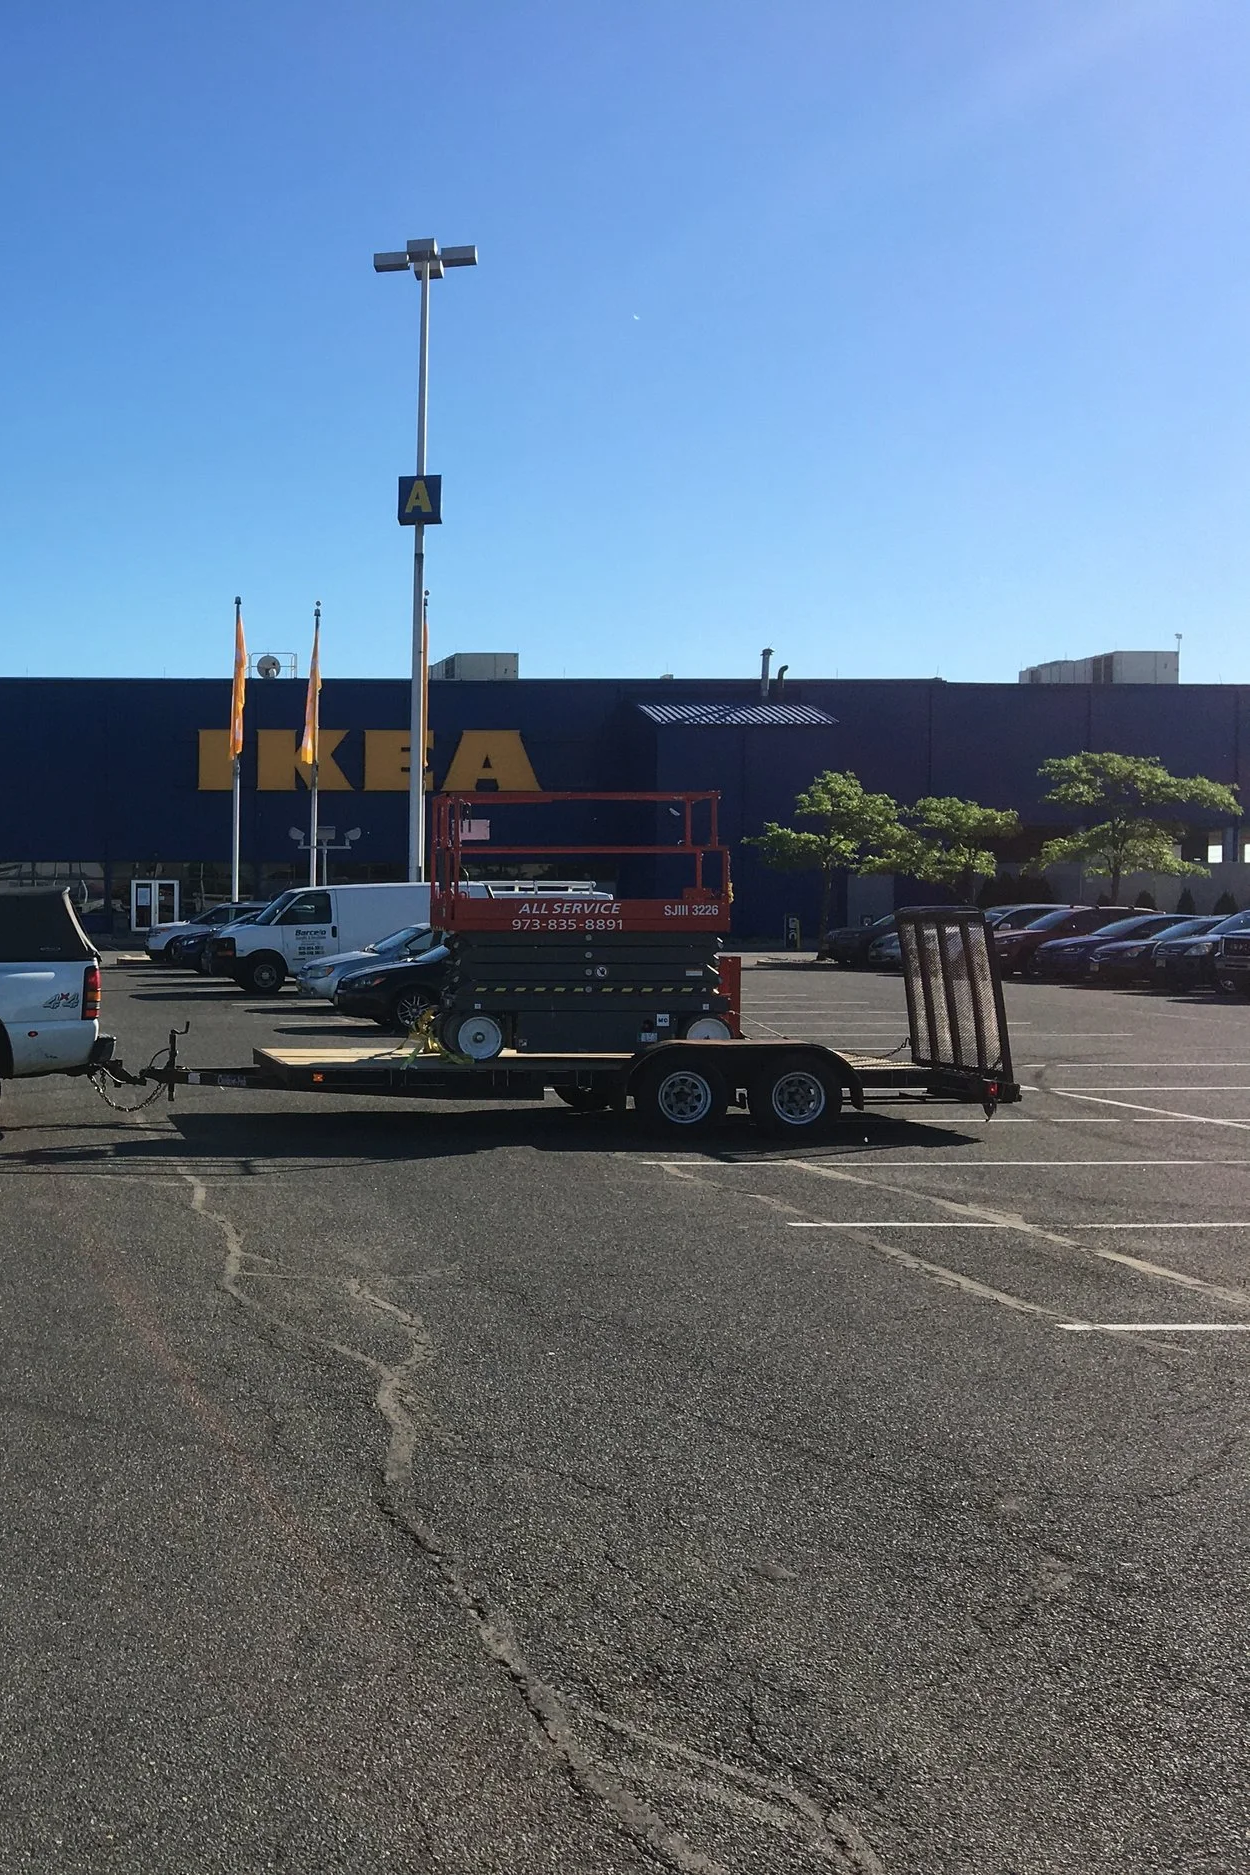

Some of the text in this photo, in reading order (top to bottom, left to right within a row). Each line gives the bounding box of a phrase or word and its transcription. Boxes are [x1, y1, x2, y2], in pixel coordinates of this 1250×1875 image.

[405, 480, 433, 513] A
[198, 729, 543, 791] IKEA
[518, 903, 621, 914] ALL SERVICE
[664, 904, 719, 916] SJIII 3226
[512, 919, 623, 930] 973-835-8891
